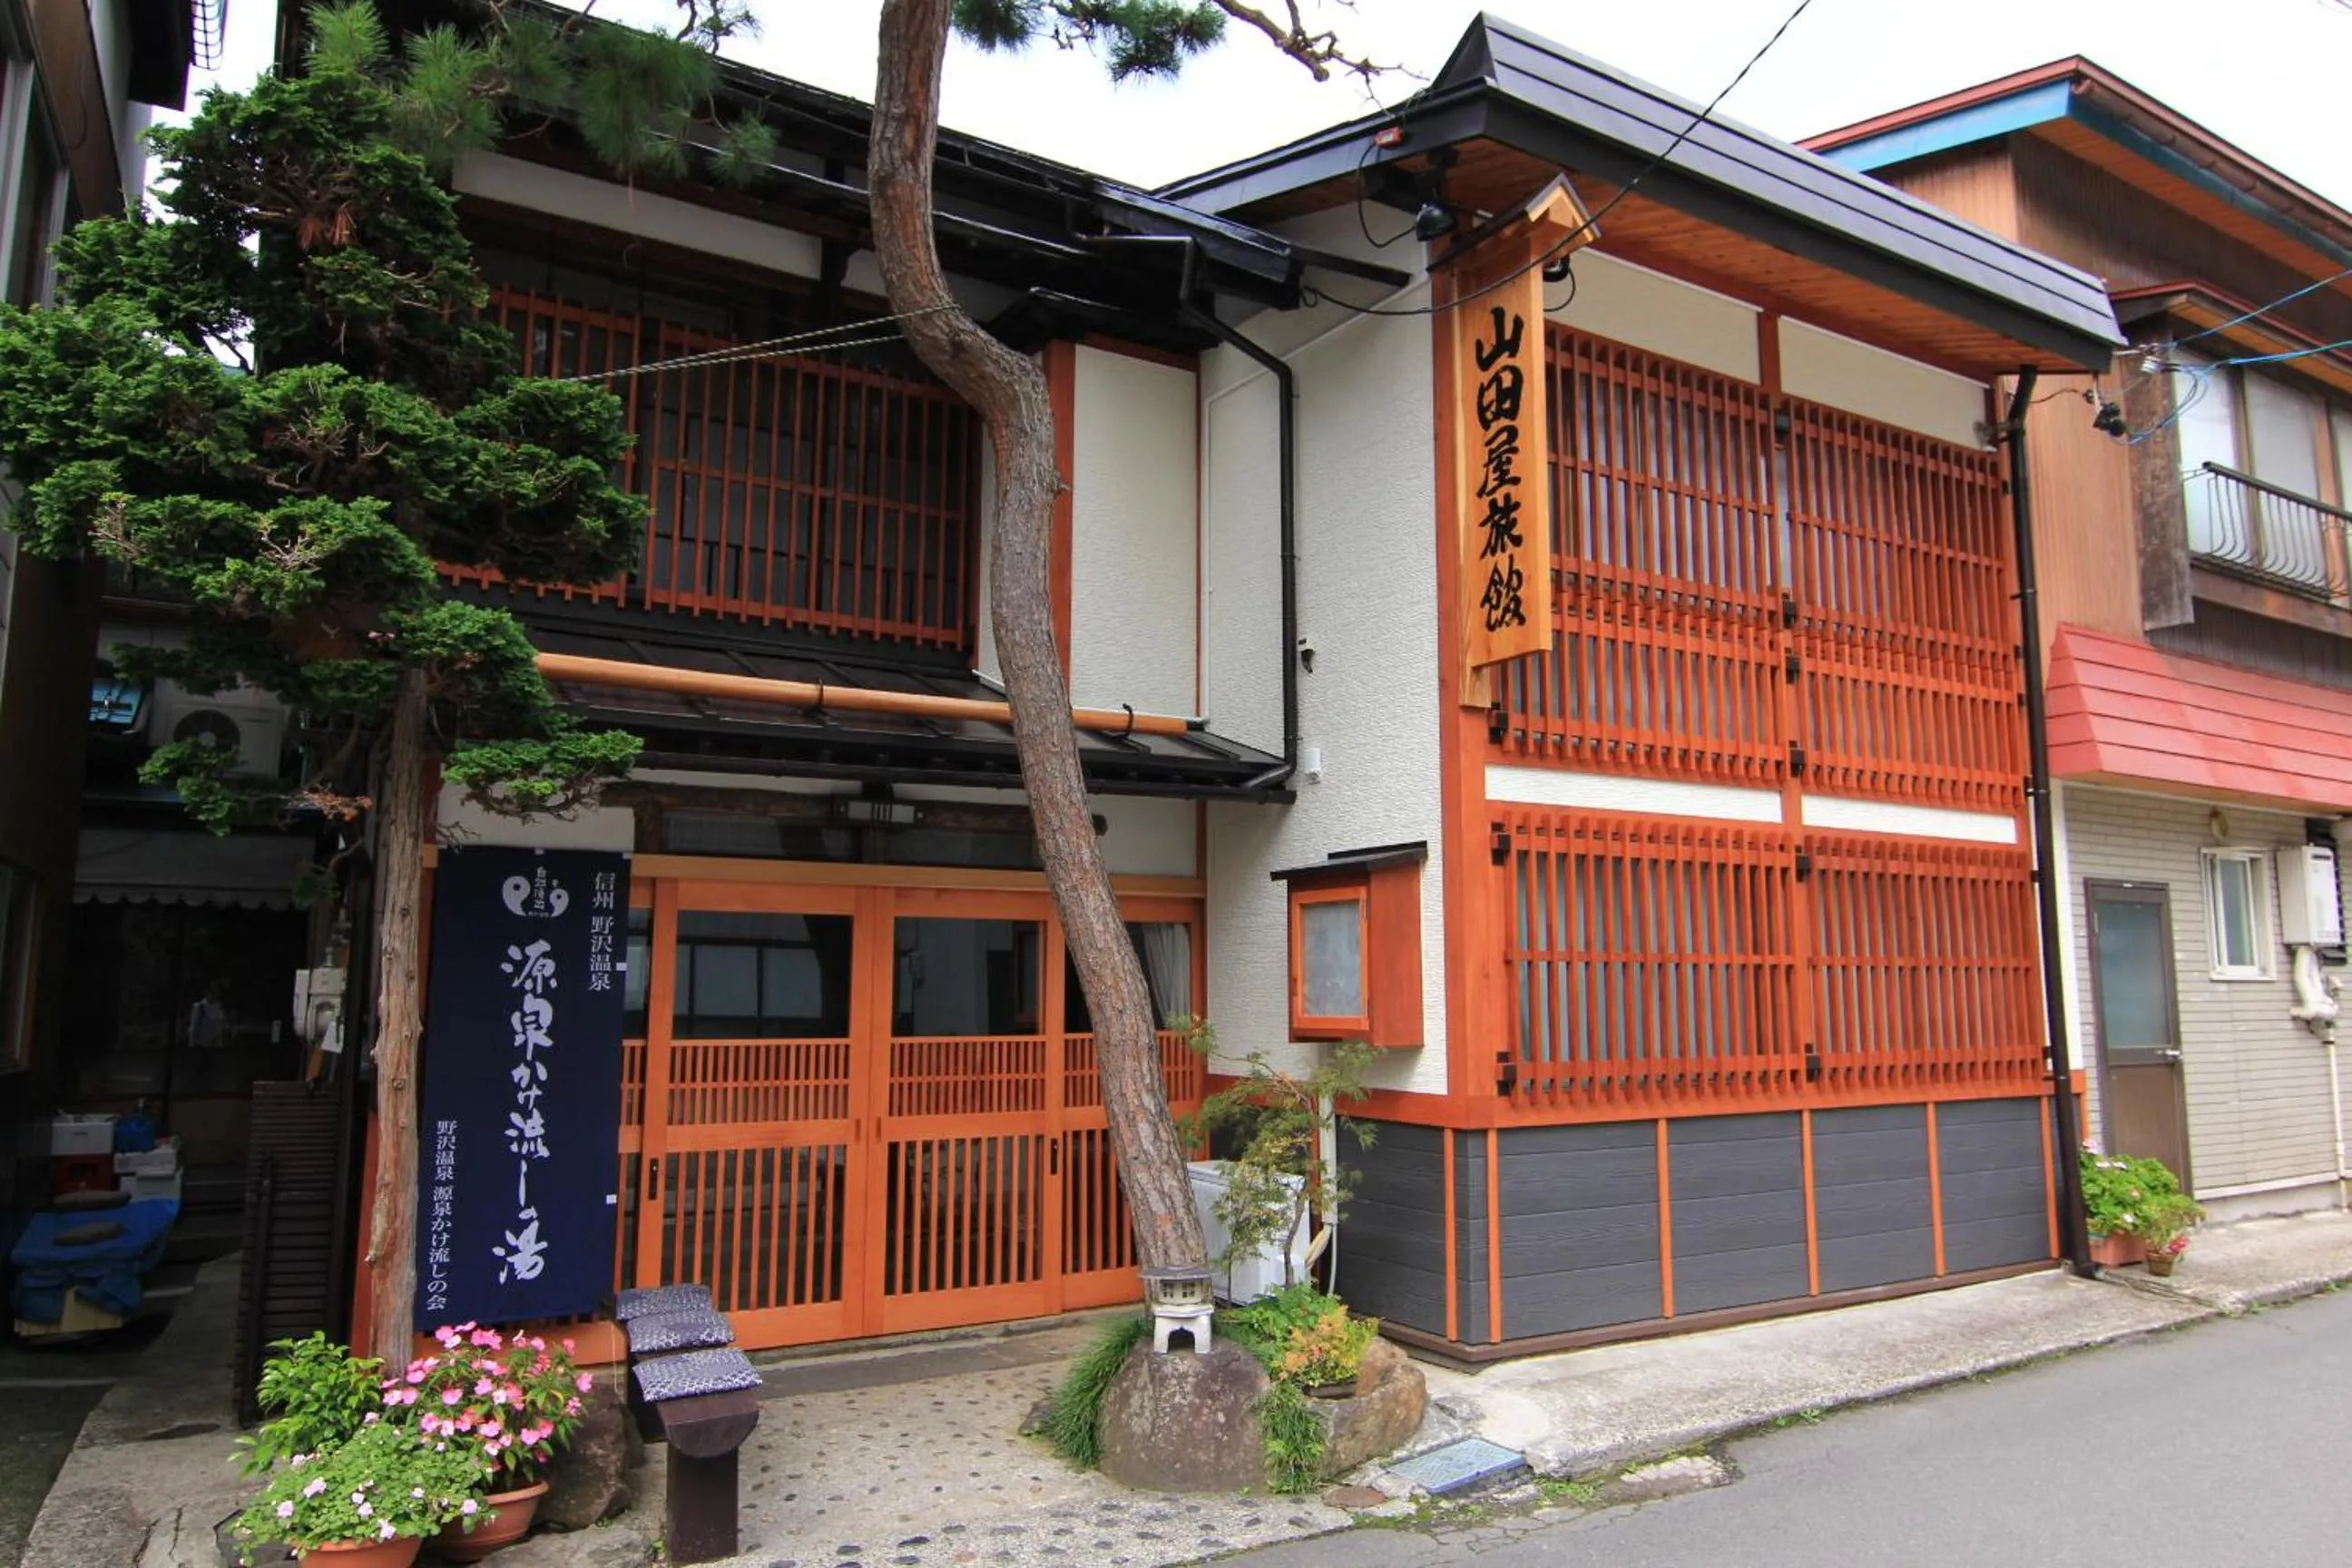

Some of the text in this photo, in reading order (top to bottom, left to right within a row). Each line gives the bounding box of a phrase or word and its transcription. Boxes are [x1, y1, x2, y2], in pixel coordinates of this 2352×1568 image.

[1475, 307, 1526, 632] 山田屋旅館
[589, 872, 615, 991] 信州 野沢温泉
[426, 1120, 457, 1311] 野沢温泉 源泉かけ流しの会
[492, 939, 557, 1285] 源泉かけ流しの湯
